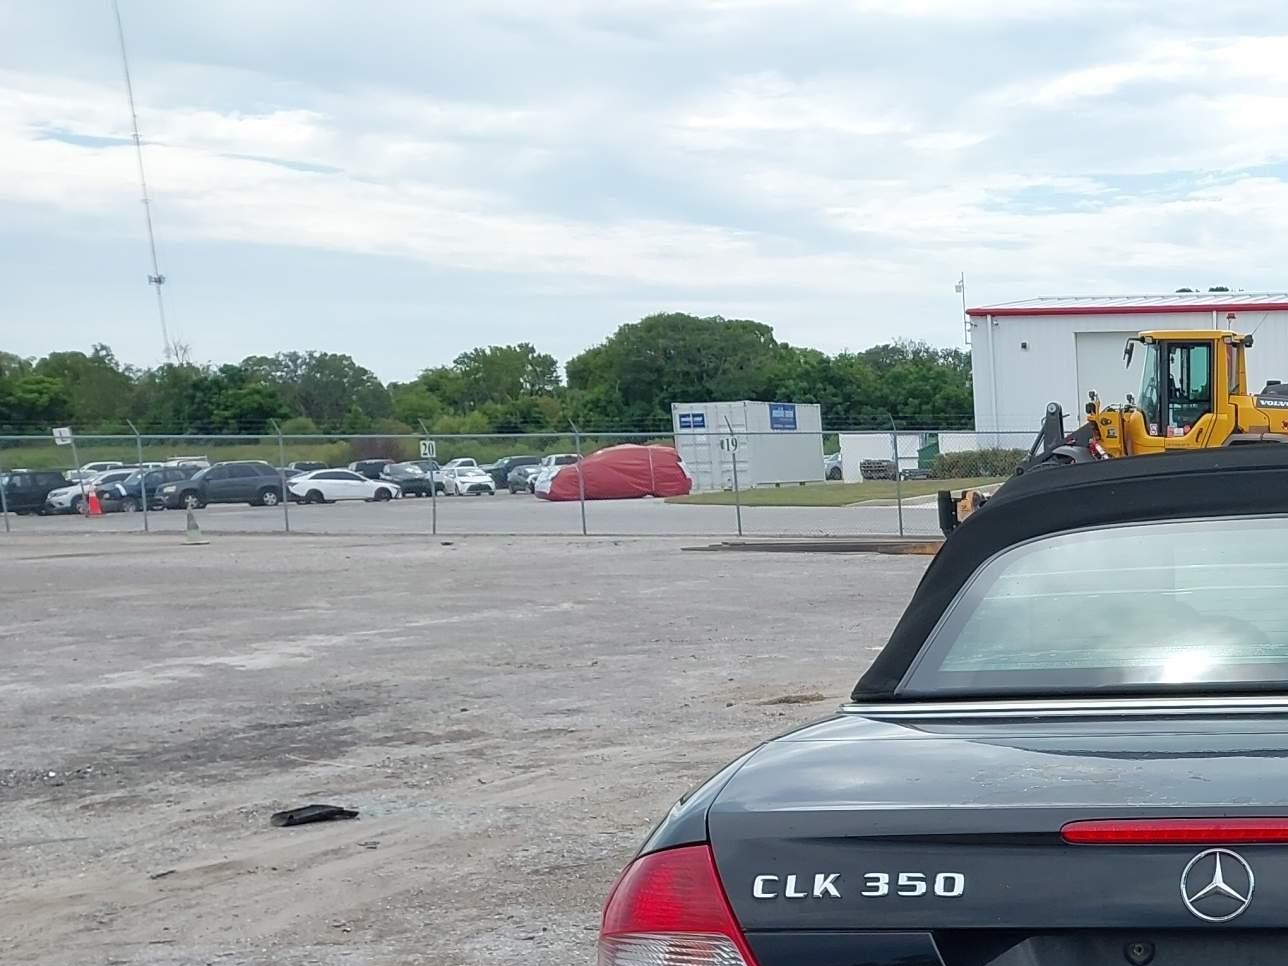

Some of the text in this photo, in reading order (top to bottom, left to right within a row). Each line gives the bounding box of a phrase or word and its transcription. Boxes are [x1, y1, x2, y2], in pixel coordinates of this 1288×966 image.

[422, 443, 434, 456] 20
[726, 438, 738, 451] 19
[752, 872, 966, 899] CLK 350
